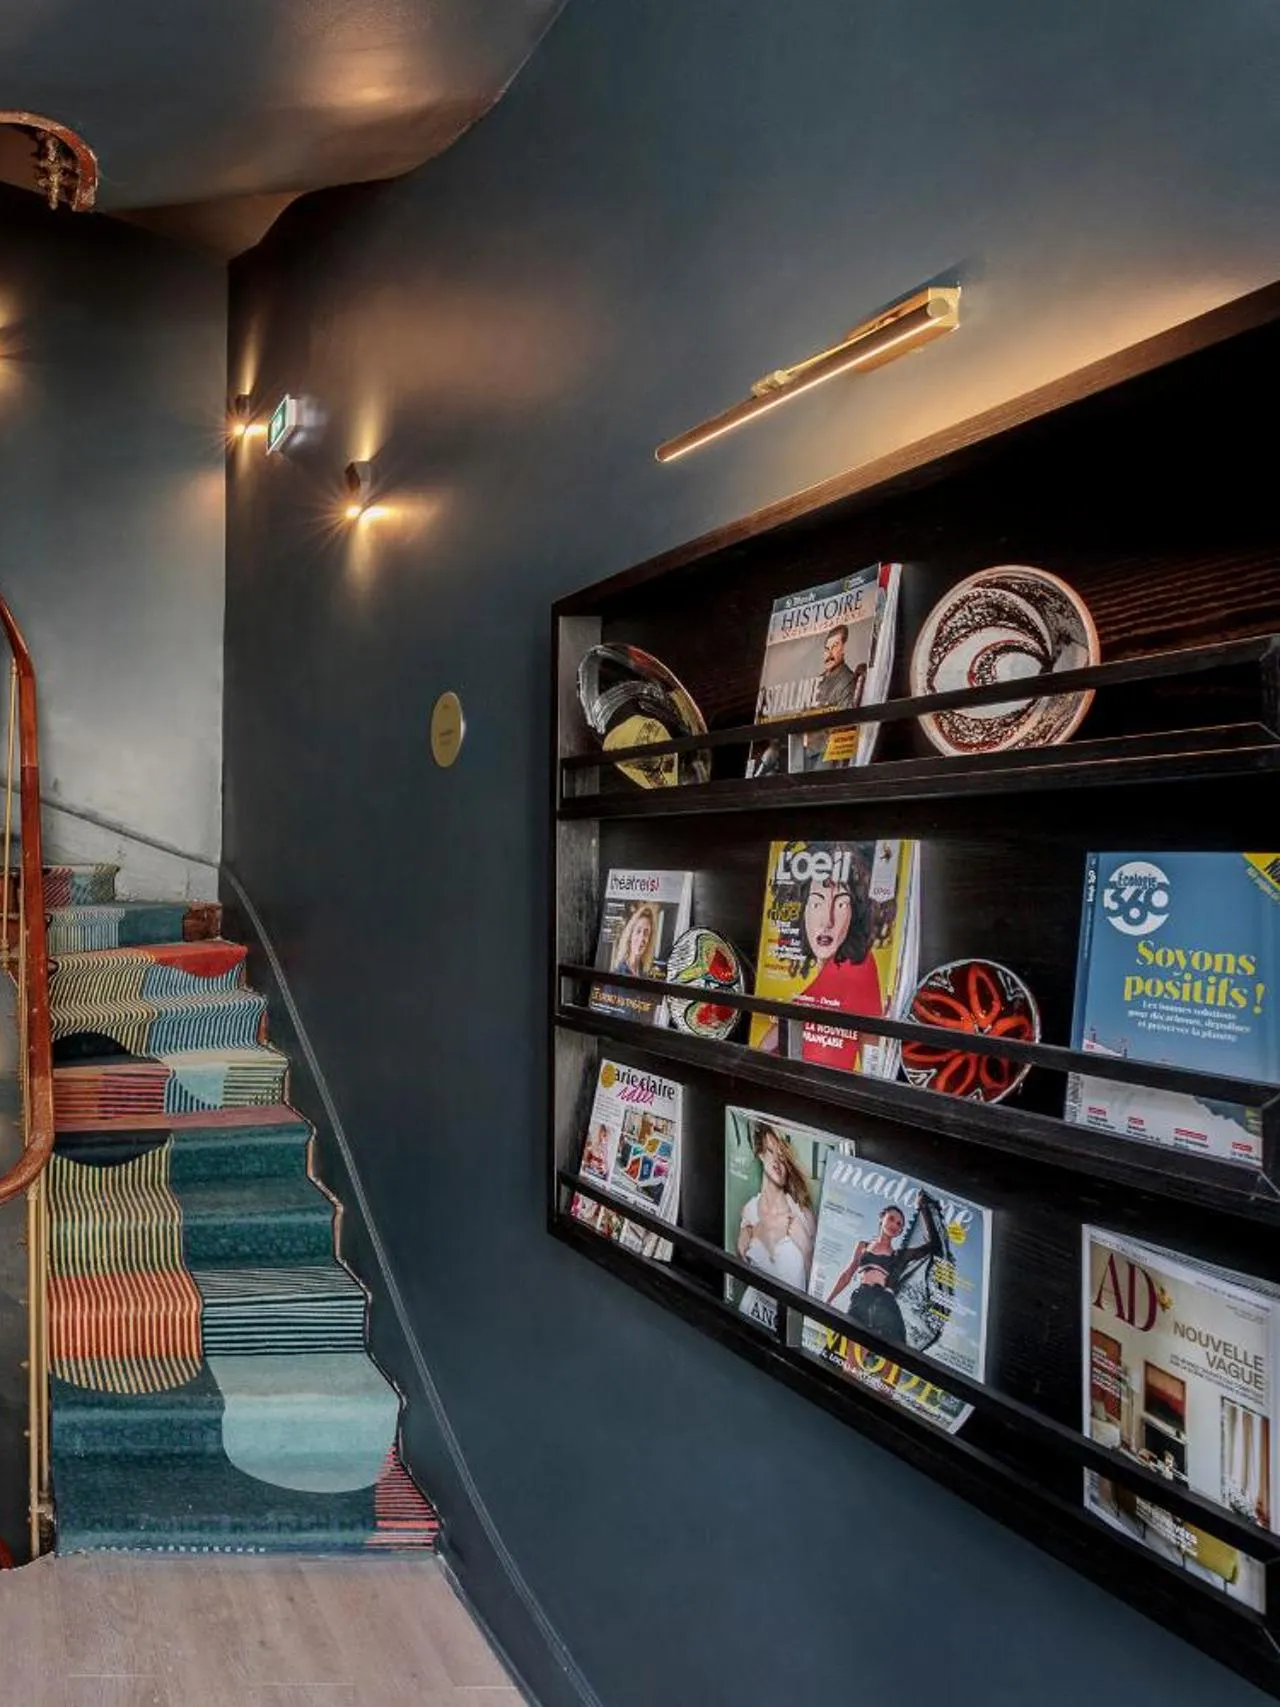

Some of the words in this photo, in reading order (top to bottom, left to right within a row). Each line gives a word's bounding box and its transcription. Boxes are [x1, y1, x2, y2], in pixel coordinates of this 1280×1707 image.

[781, 590, 864, 630] HISTOIRE
[762, 676, 824, 715] STALINE
[610, 873, 660, 892] théâtre(s)
[1117, 871, 1159, 889] Écologie
[1103, 884, 1170, 926] 360
[1136, 940, 1257, 977] Soyons
[1123, 973, 1249, 1010] positifs
[1252, 983, 1265, 1015] !
[817, 1023, 859, 1041] NOUVELLE
[613, 1066, 639, 1087] arie
[641, 1078, 676, 1100] claire
[1093, 1253, 1159, 1332] AD
[1173, 1321, 1266, 1374] NOUVELLE
[1204, 1350, 1266, 1392] VAGUE
